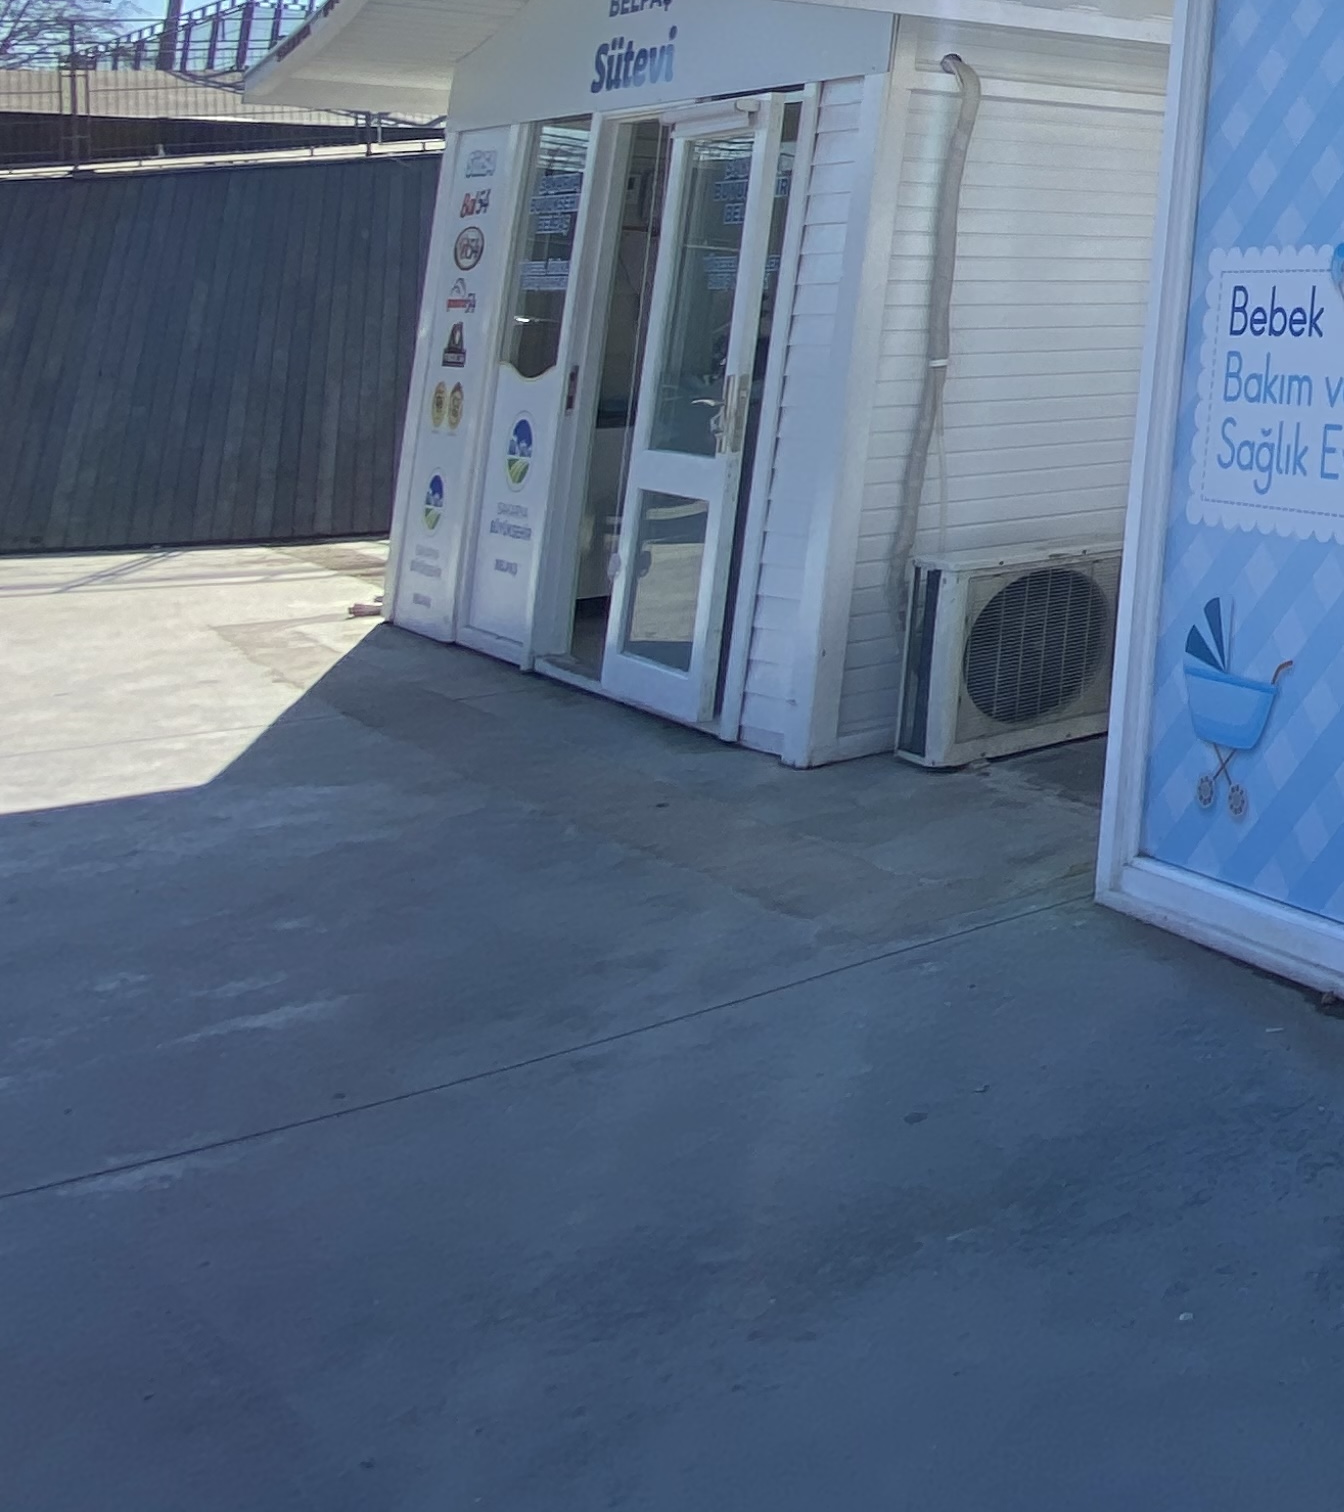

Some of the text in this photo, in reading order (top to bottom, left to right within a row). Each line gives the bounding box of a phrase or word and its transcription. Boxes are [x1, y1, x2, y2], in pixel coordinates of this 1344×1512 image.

[1229, 285, 1325, 338] Bebek
[1223, 350, 1313, 407] Bakım
[1217, 416, 1309, 495] Sağlık
